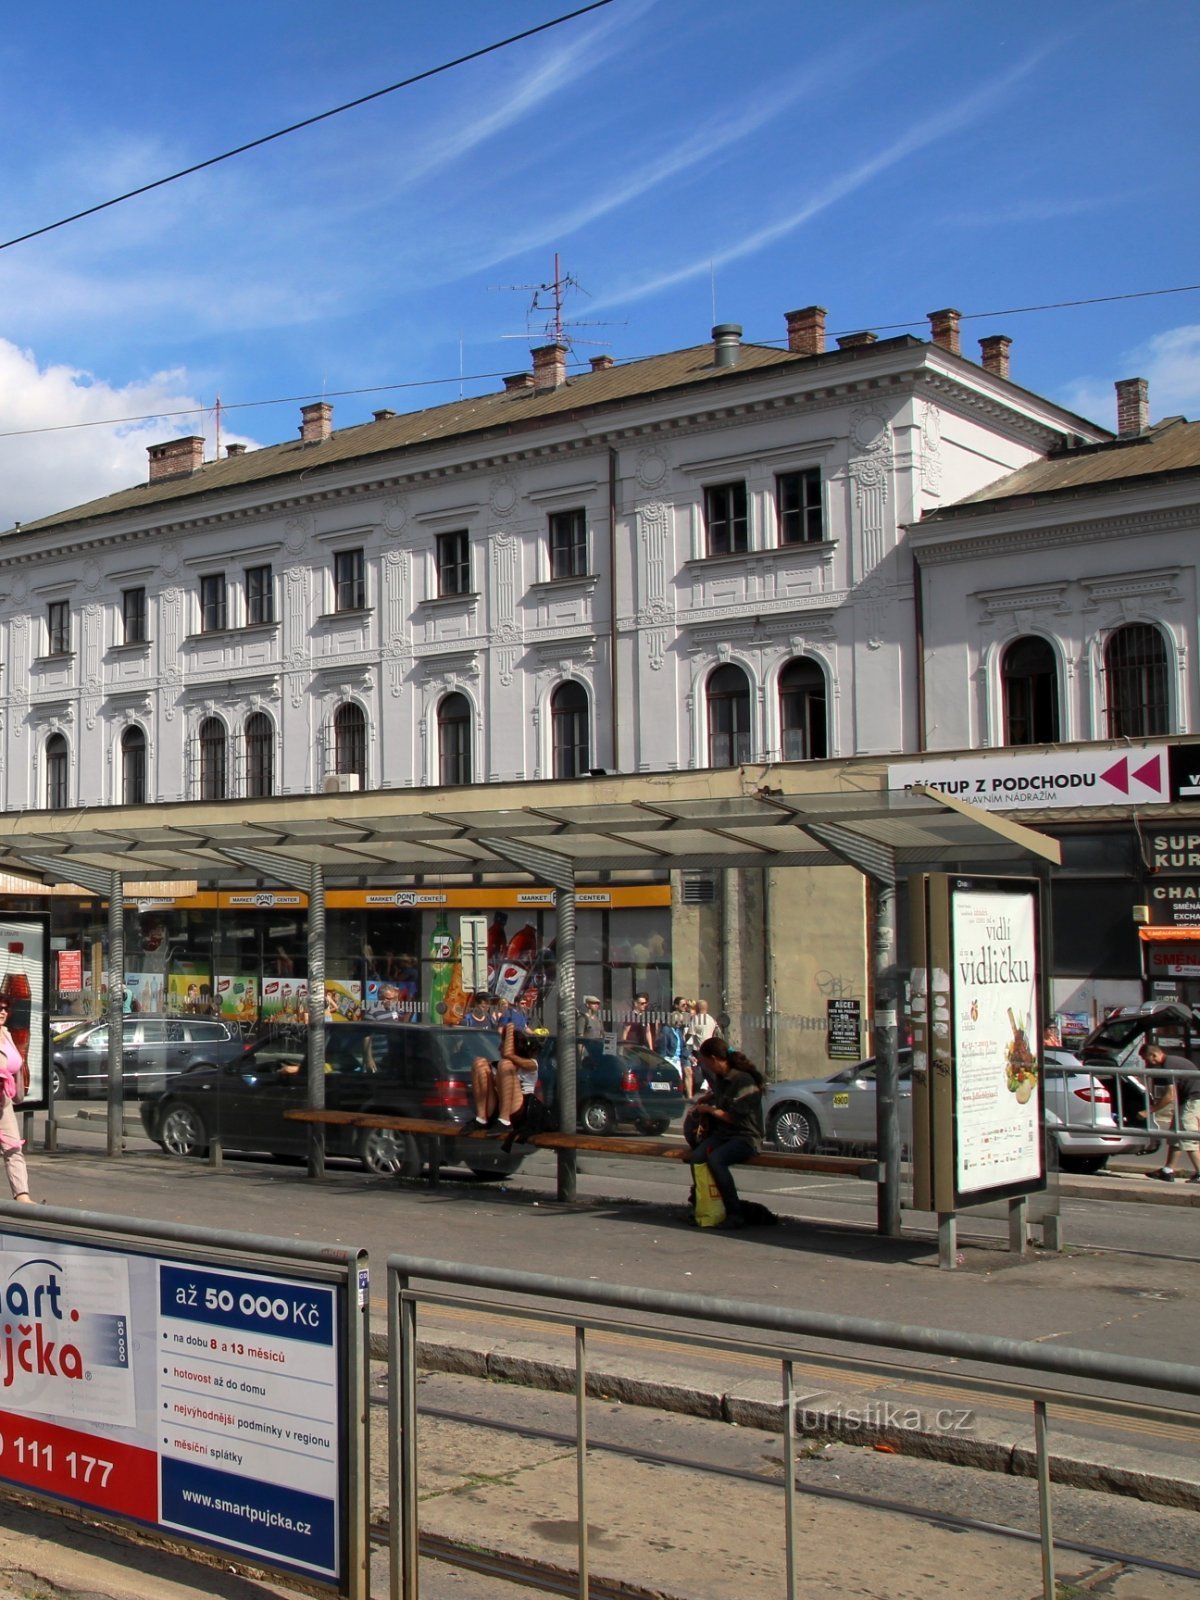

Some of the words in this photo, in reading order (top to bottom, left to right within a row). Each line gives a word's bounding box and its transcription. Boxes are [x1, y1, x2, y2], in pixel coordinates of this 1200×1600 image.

[976, 779, 986, 792] Z
[993, 773, 1096, 791] PODCHODU
[962, 793, 1003, 804] HLAVNÍM
[1005, 792, 1057, 803] NÁDRAŽÍM
[397, 894, 415, 904] PONT
[1154, 887, 1200, 899] CHA
[960, 946, 1030, 985] vidličku
[176, 1283, 198, 1306] až
[205, 1287, 234, 1311] 50
[239, 1293, 289, 1321] 000
[293, 1300, 320, 1327] Kč
[117, 1320, 125, 1336] 50
[173, 1334, 184, 1343] na
[186, 1335, 208, 1349] dobu
[210, 1338, 218, 1350] 8
[221, 1343, 228, 1352] a
[231, 1343, 244, 1355] 13
[247, 1348, 285, 1364] měsíců
[173, 1367, 211, 1385] hotovost
[213, 1374, 224, 1387] až
[226, 1378, 238, 1390] do
[240, 1381, 266, 1396] domu
[173, 1403, 235, 1426] nejvýhodnější
[237, 1417, 283, 1439] podmínky
[285, 1430, 291, 1438] v
[293, 1432, 330, 1448] regionu
[13, 1437, 53, 1472] 111
[66, 1451, 113, 1488] 177
[174, 1438, 208, 1455] měsíční
[210, 1444, 243, 1465] splátky
[182, 1489, 312, 1536] www.smartpujcka.cz
